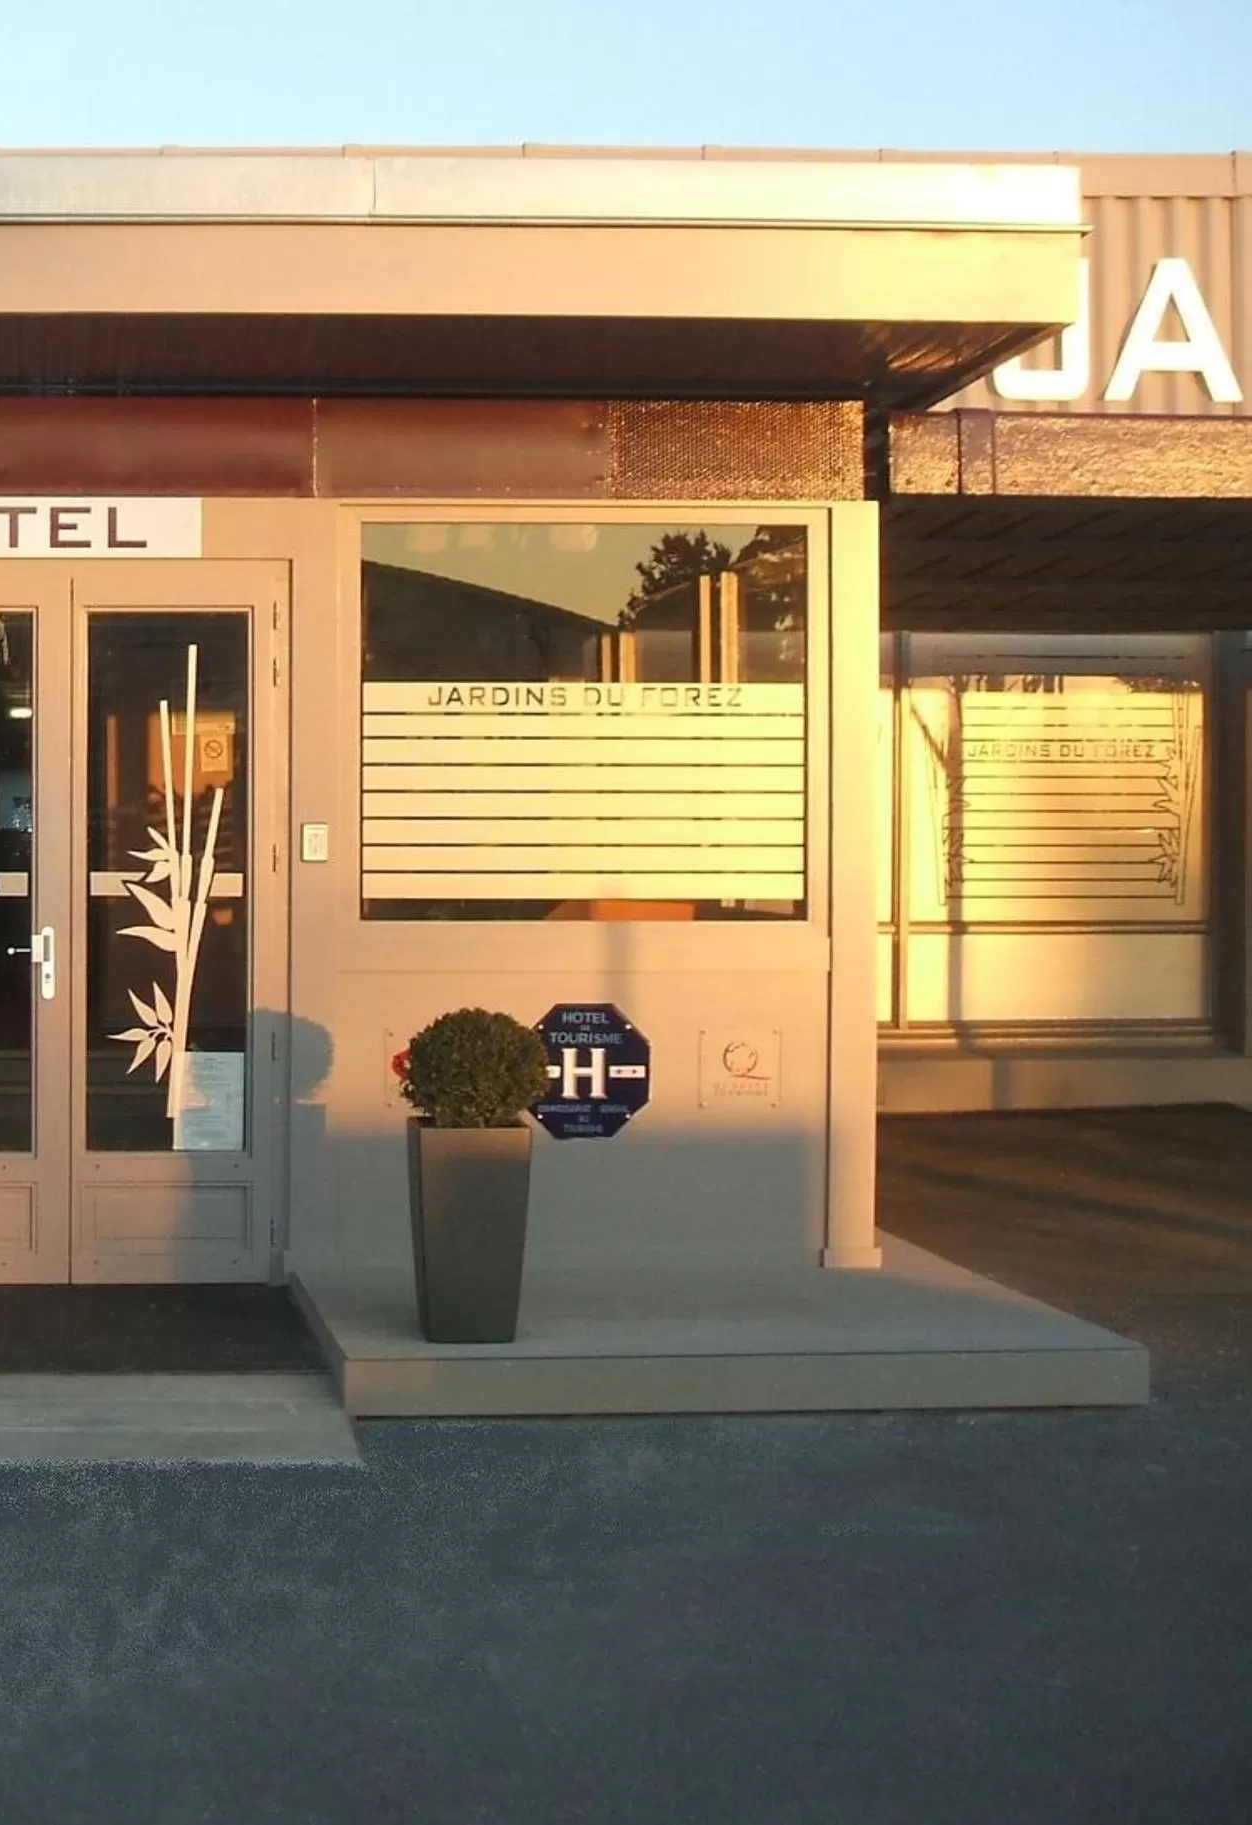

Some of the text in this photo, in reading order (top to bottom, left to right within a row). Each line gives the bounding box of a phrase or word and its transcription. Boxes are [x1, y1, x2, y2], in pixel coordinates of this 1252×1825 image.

[427, 687, 743, 707] JARDINS DU FOREZ
[561, 1011, 610, 1024] HOTEL
[549, 1031, 625, 1045] TOURISME
[561, 1048, 607, 1099] H
